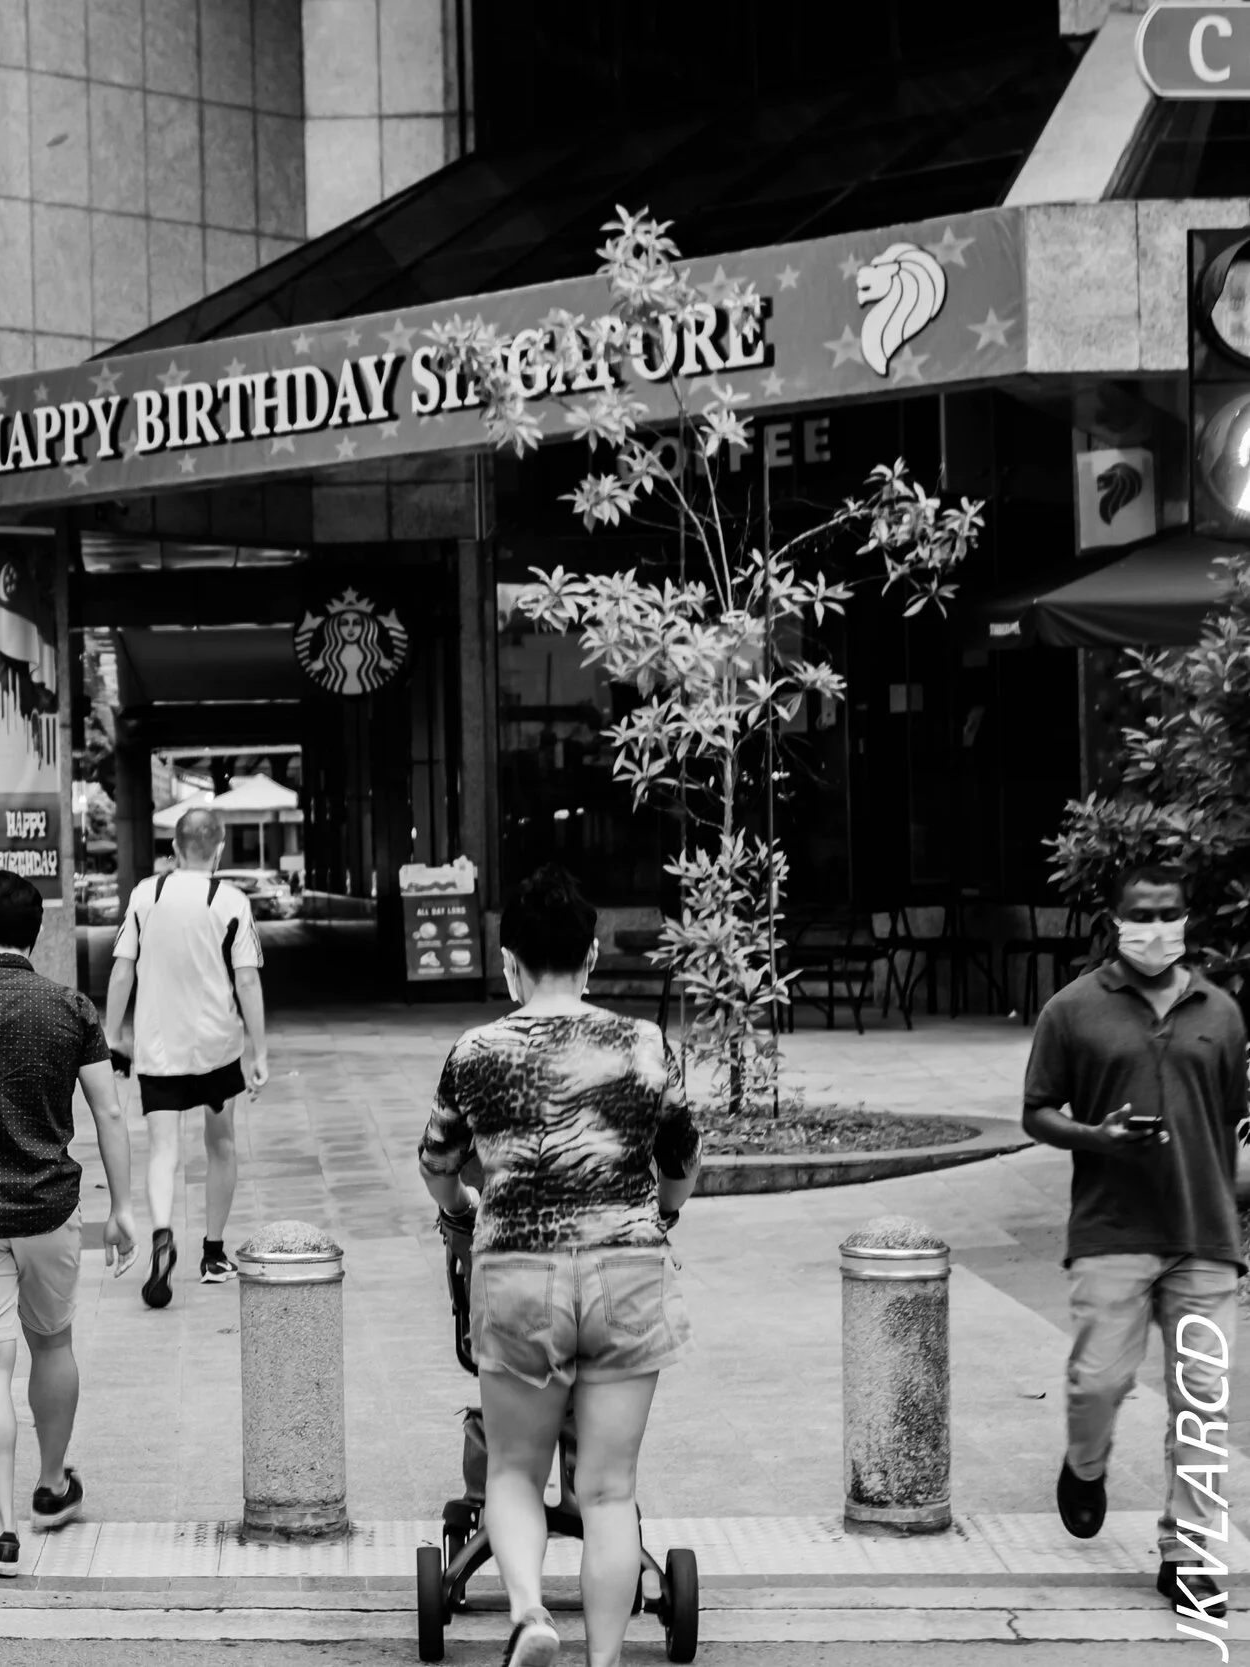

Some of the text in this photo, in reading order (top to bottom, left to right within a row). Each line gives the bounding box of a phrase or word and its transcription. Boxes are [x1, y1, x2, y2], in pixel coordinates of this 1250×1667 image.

[1189, 14, 1232, 82] C
[133, 353, 397, 453] BIRTHDAY
[6, 811, 46, 838] HAPPY
